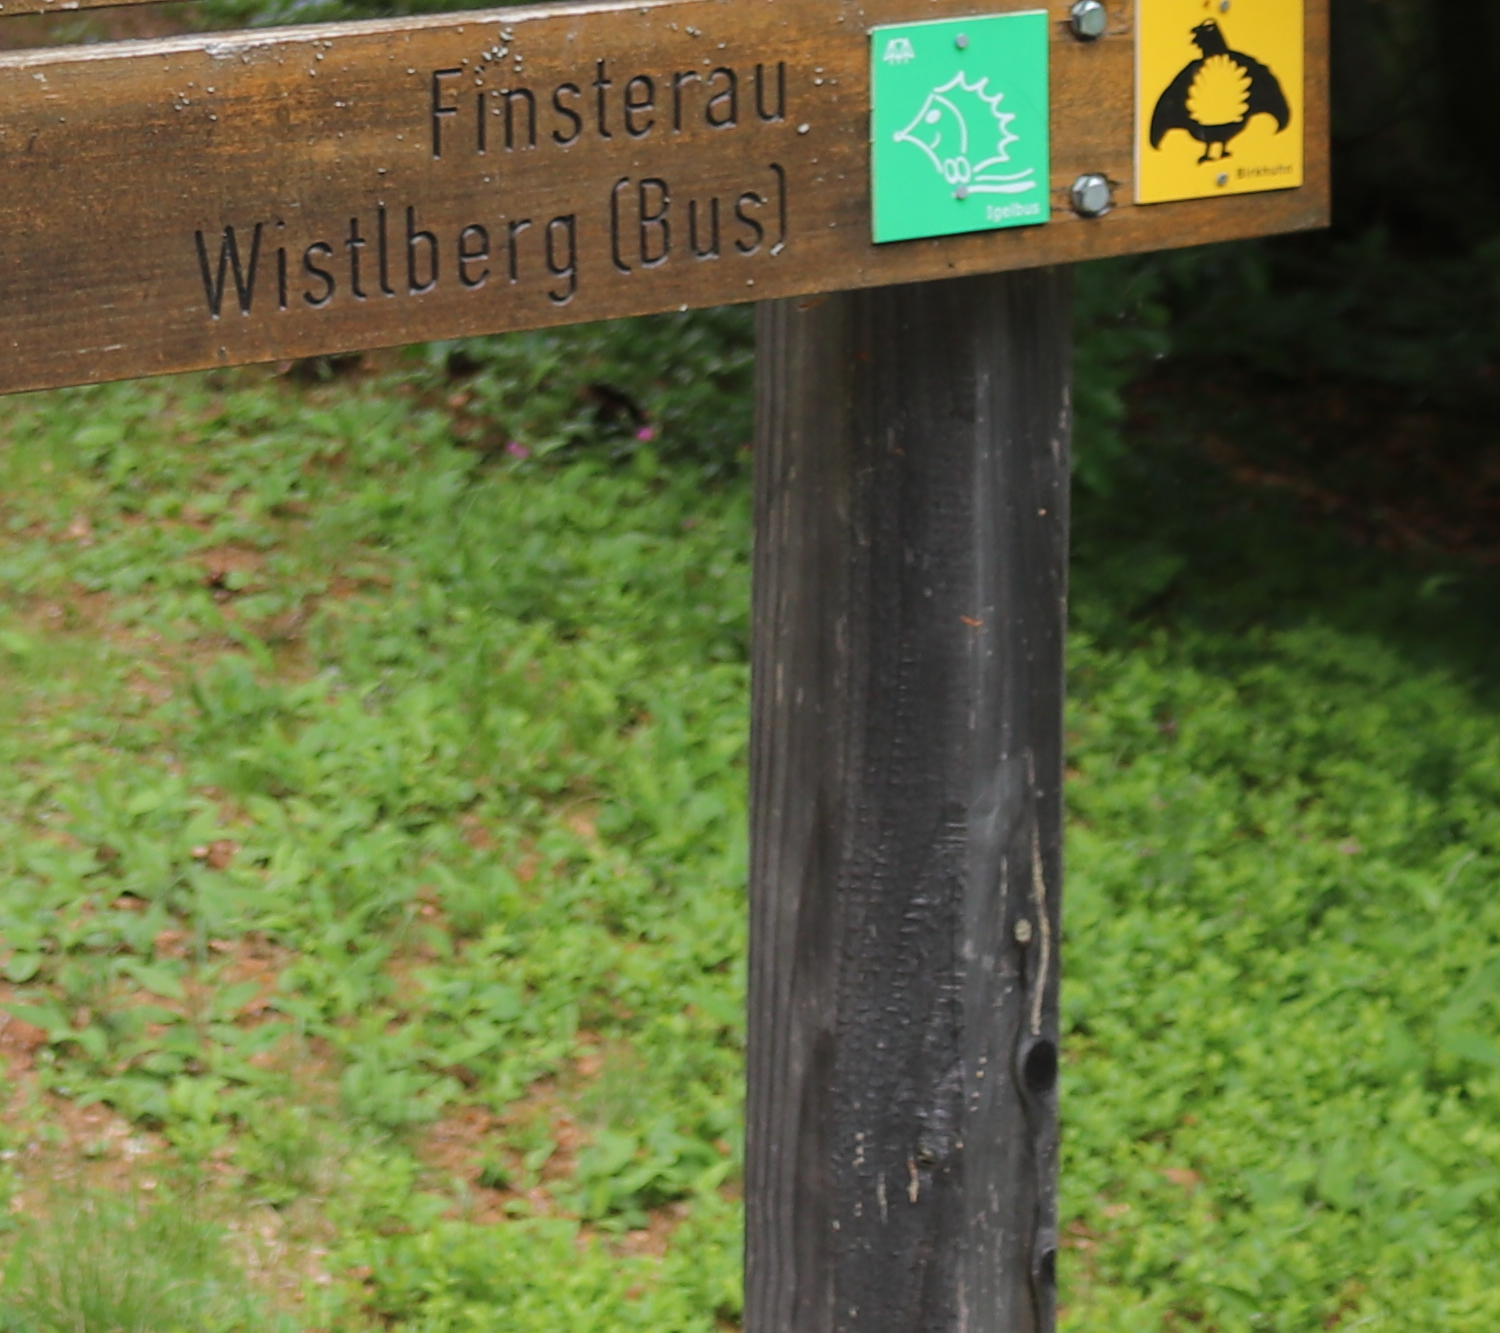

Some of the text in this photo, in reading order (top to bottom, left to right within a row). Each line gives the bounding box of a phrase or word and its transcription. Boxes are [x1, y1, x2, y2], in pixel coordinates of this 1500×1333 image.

[431, 59, 787, 160] Finsterau
[1236, 163, 1294, 180] Birkhuhn
[195, 162, 789, 320] Wistlberg (Bus)
[986, 201, 1042, 223] Igelbus
